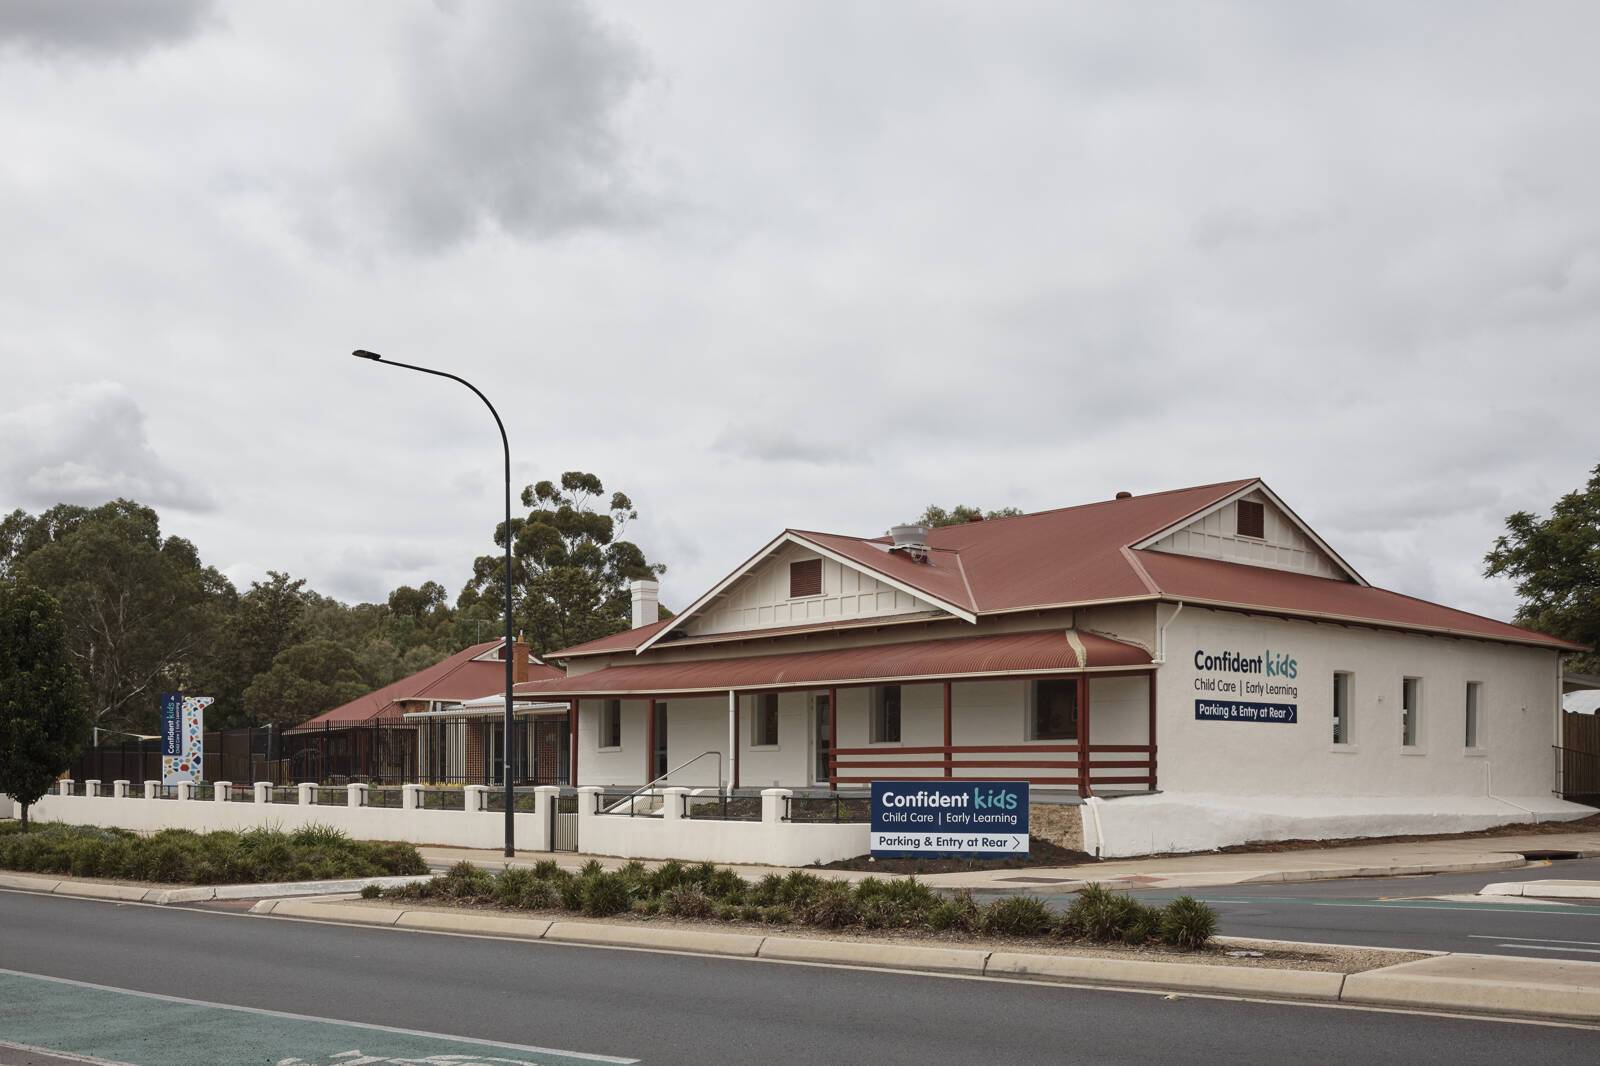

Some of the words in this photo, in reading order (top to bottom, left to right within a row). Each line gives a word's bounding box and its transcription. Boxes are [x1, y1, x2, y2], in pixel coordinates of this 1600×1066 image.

[1194, 650, 1262, 674] Confident
[1266, 649, 1297, 679] kids
[1194, 678, 1215, 691] Child
[1218, 680, 1236, 692] Care
[1246, 682, 1264, 697] Early
[1266, 683, 1297, 699] Learning
[166, 702, 174, 719] kids
[1199, 703, 1229, 718] Parking
[1231, 705, 1237, 716] &
[1239, 706, 1258, 719] Entry
[1260, 707, 1267, 717] at
[1269, 707, 1286, 718] Rear
[882, 791, 969, 808] Confident
[974, 787, 1017, 810] kids
[882, 812, 907, 823] Child
[910, 812, 934, 823] Care
[946, 812, 970, 825] Early
[973, 812, 1017, 825] Learning
[879, 836, 920, 849] Parking
[924, 837, 933, 847] &
[936, 837, 963, 849] Entry
[967, 838, 978, 848] at
[982, 838, 1008, 848] Rear
